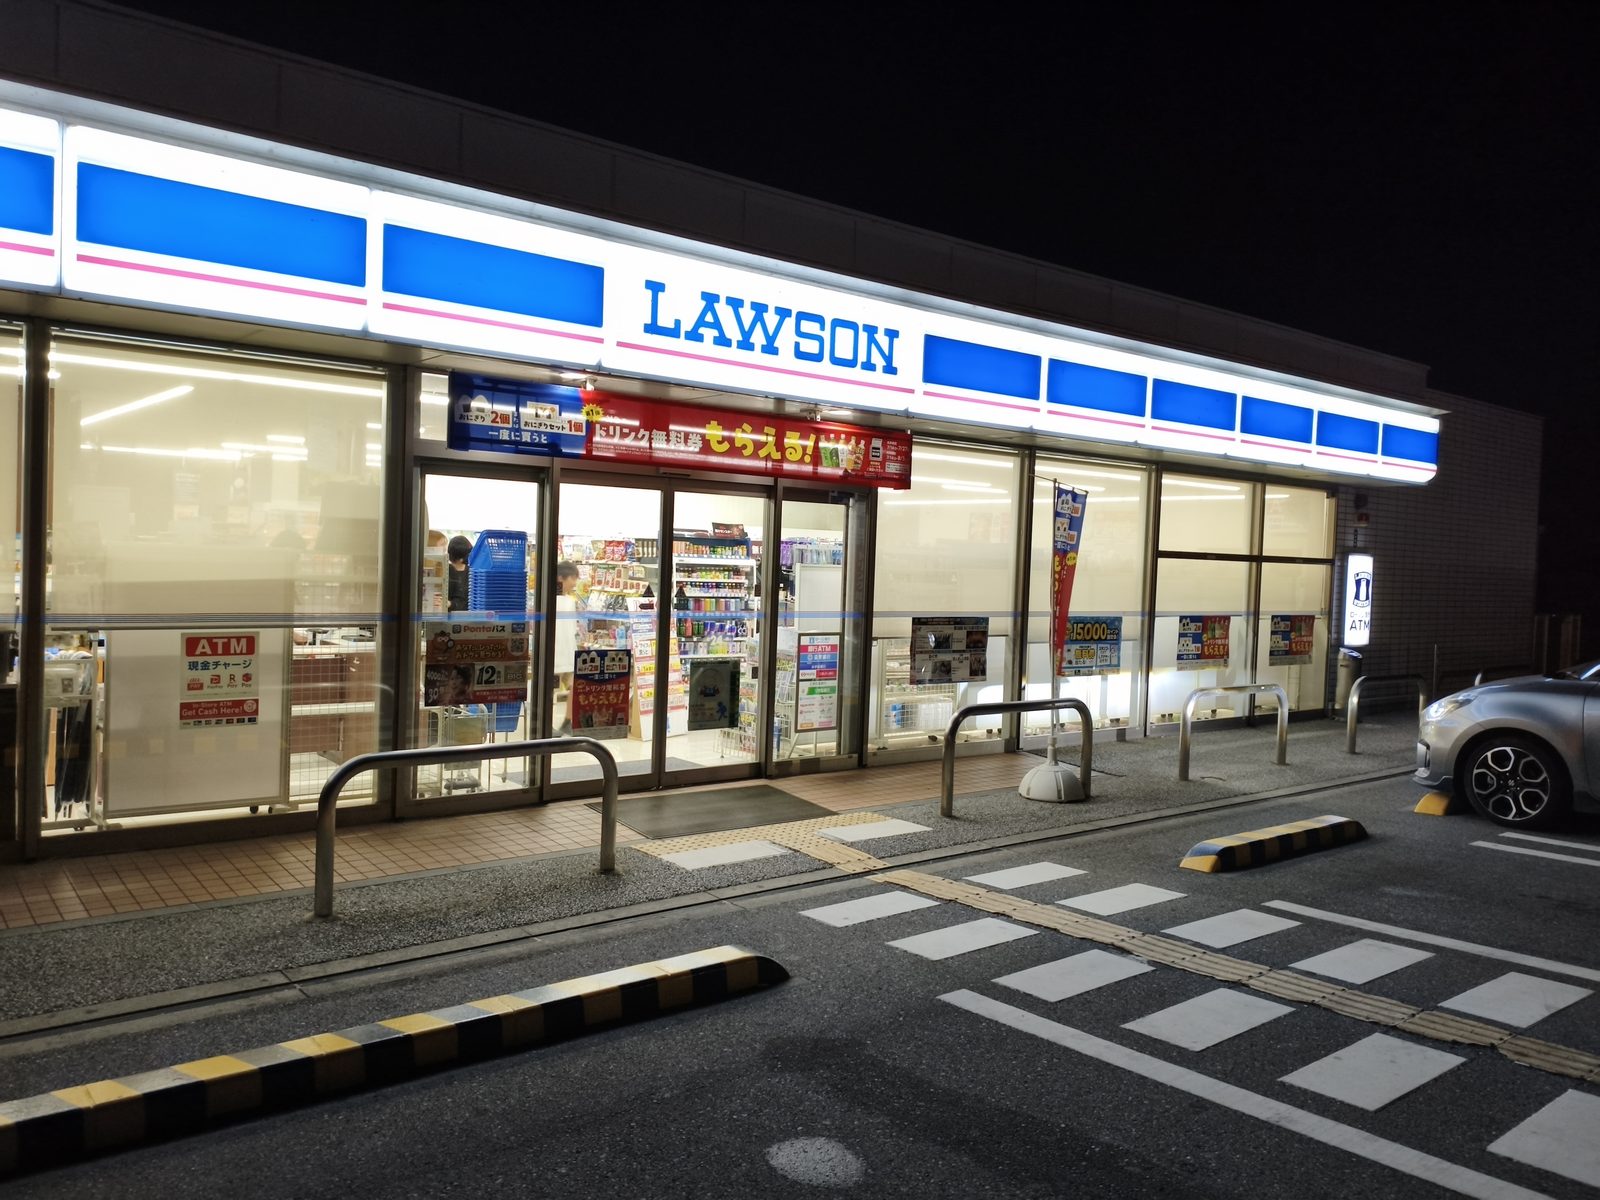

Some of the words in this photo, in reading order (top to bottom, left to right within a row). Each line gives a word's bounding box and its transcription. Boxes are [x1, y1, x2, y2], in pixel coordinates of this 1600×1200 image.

[643, 279, 900, 375] LAWSON
[490, 410, 511, 425] 2個
[523, 420, 567, 432] おにぎりセット
[567, 420, 584, 433] 1個
[488, 430, 548, 444] 一度に買うと
[594, 424, 703, 452] ドリンク無料券
[463, 625, 506, 633] Pontaパス
[1349, 619, 1370, 631] ATM
[195, 638, 248, 655] ATM
[188, 660, 253, 671] 現金チャージ
[476, 665, 496, 685] 12
[198, 707, 218, 715] Cash
[220, 706, 243, 714] Here!
